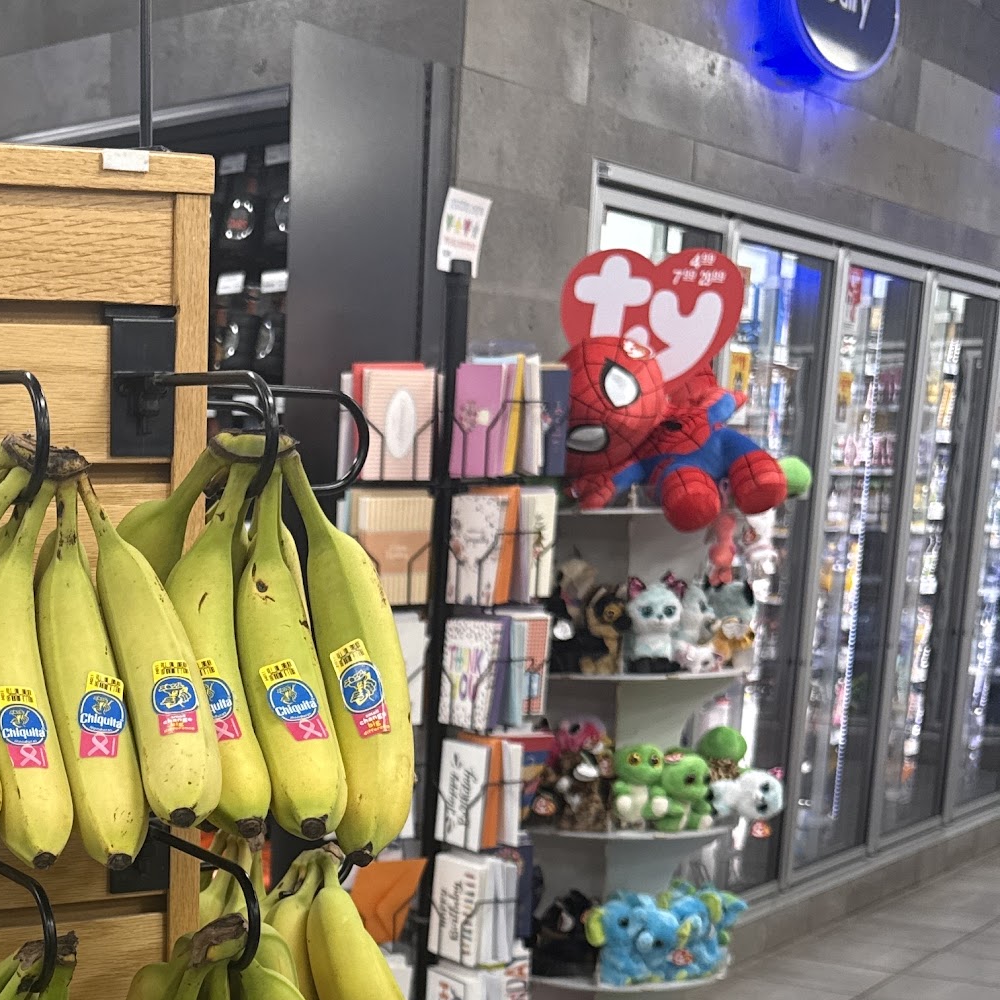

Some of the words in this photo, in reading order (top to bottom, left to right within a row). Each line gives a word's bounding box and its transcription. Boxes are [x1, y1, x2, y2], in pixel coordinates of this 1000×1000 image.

[573, 254, 724, 382] ty
[209, 699, 233, 715] quita
[274, 701, 318, 718] Chiquita
[80, 712, 123, 730] Chiquita
[2, 727, 46, 739] Chiquita
